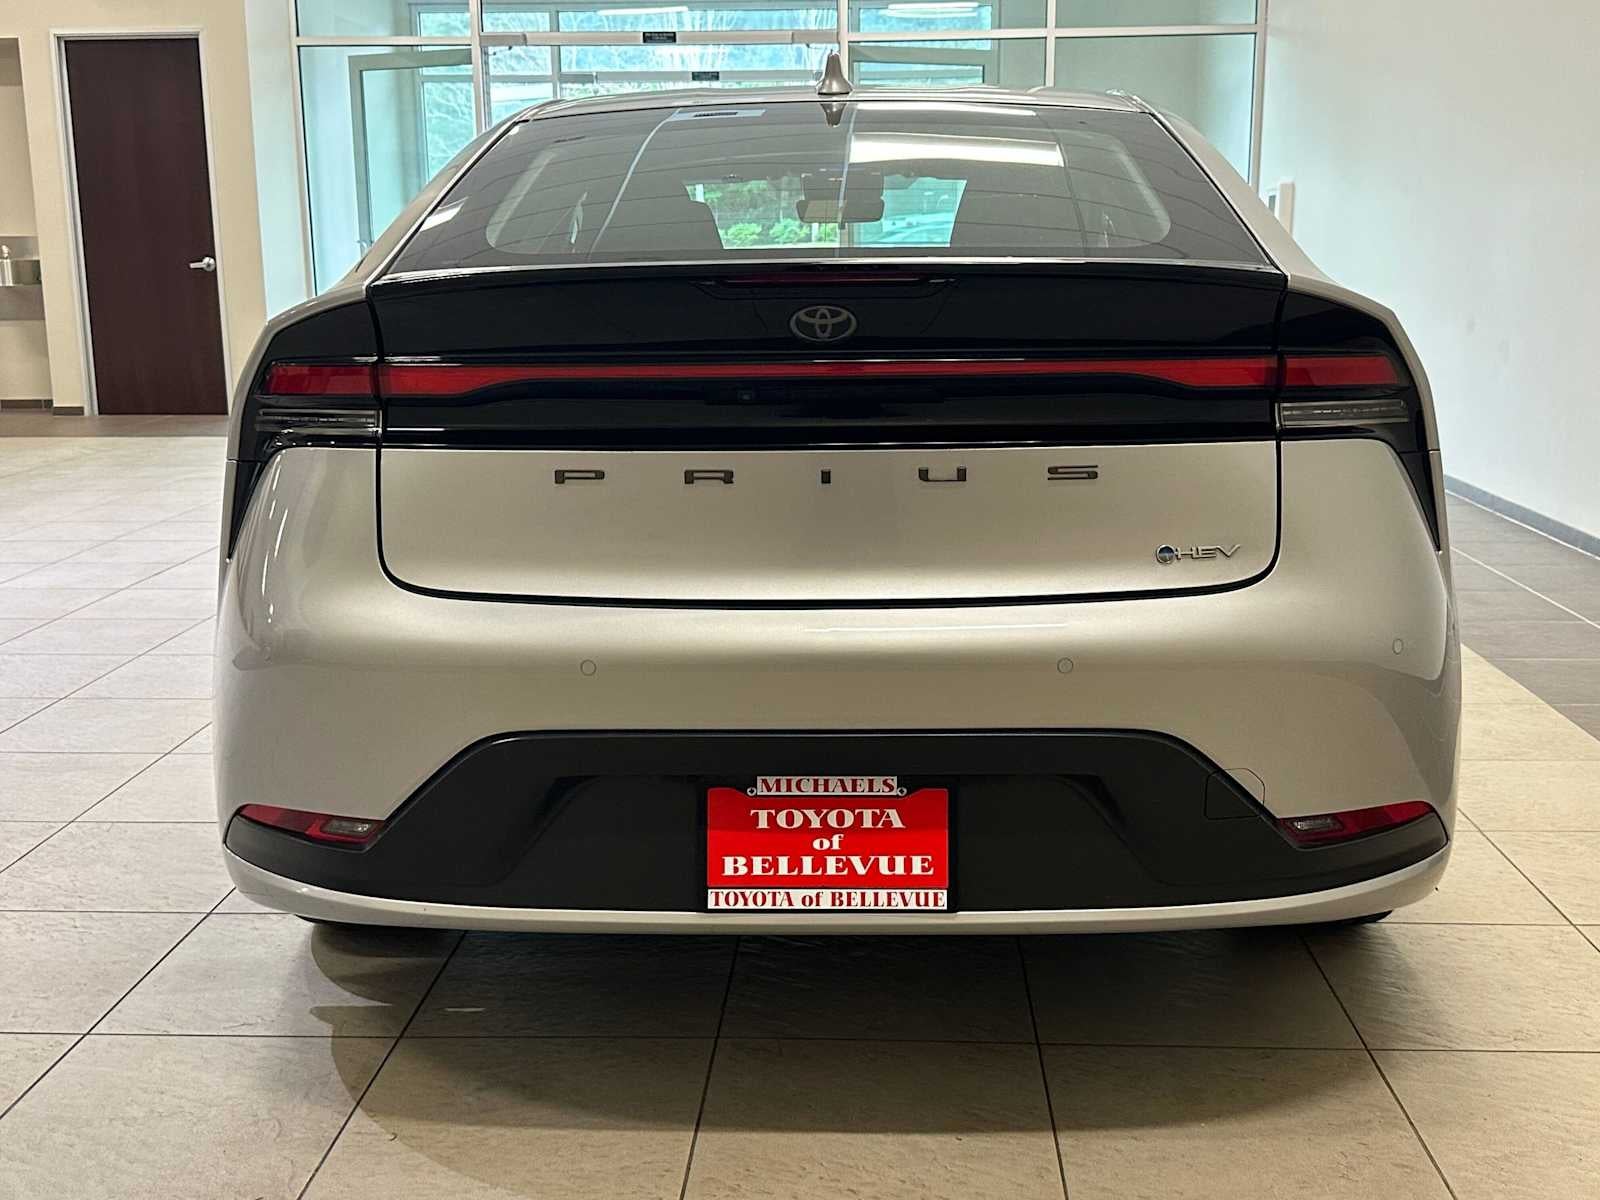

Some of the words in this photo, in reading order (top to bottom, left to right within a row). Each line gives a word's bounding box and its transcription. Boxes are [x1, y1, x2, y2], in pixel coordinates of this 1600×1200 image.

[554, 465, 1099, 485] PRIUS
[1176, 544, 1241, 560] HEV
[760, 777, 895, 793] MICHAELS
[750, 808, 906, 829] TOYOTA
[812, 833, 844, 850] of
[722, 855, 934, 876] BELLEVUE
[711, 890, 793, 907] TOYOTA
[801, 890, 823, 907] of
[830, 890, 945, 907] BELLEVUE
